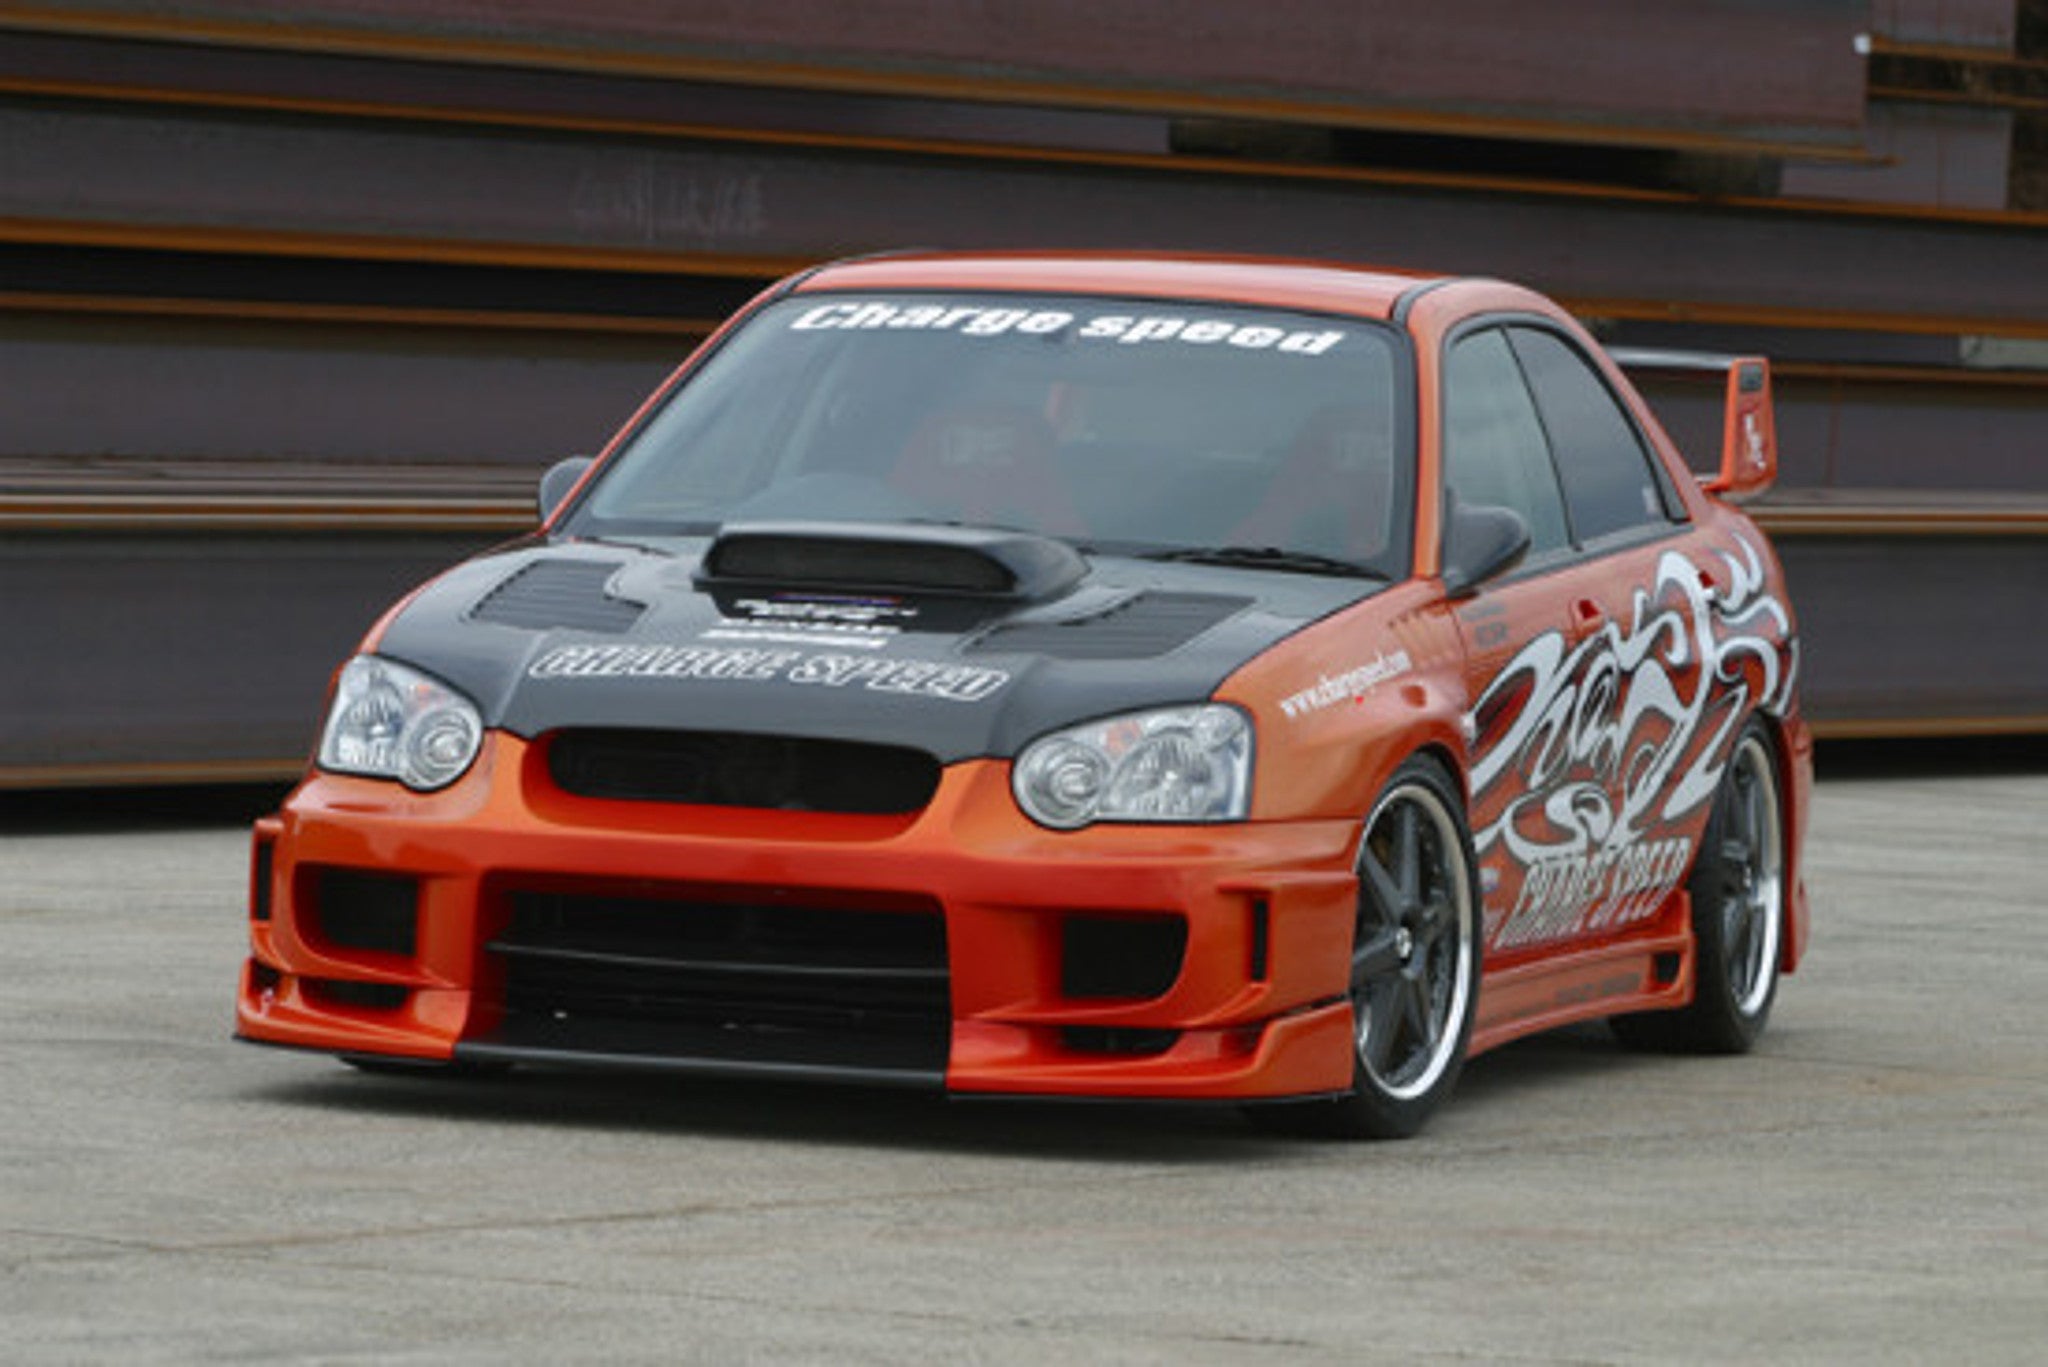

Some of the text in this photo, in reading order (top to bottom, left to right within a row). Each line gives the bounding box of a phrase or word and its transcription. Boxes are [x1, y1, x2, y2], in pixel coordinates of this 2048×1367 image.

[1079, 315, 1345, 356] speed
[528, 645, 1010, 701] CHARGE SPEED
